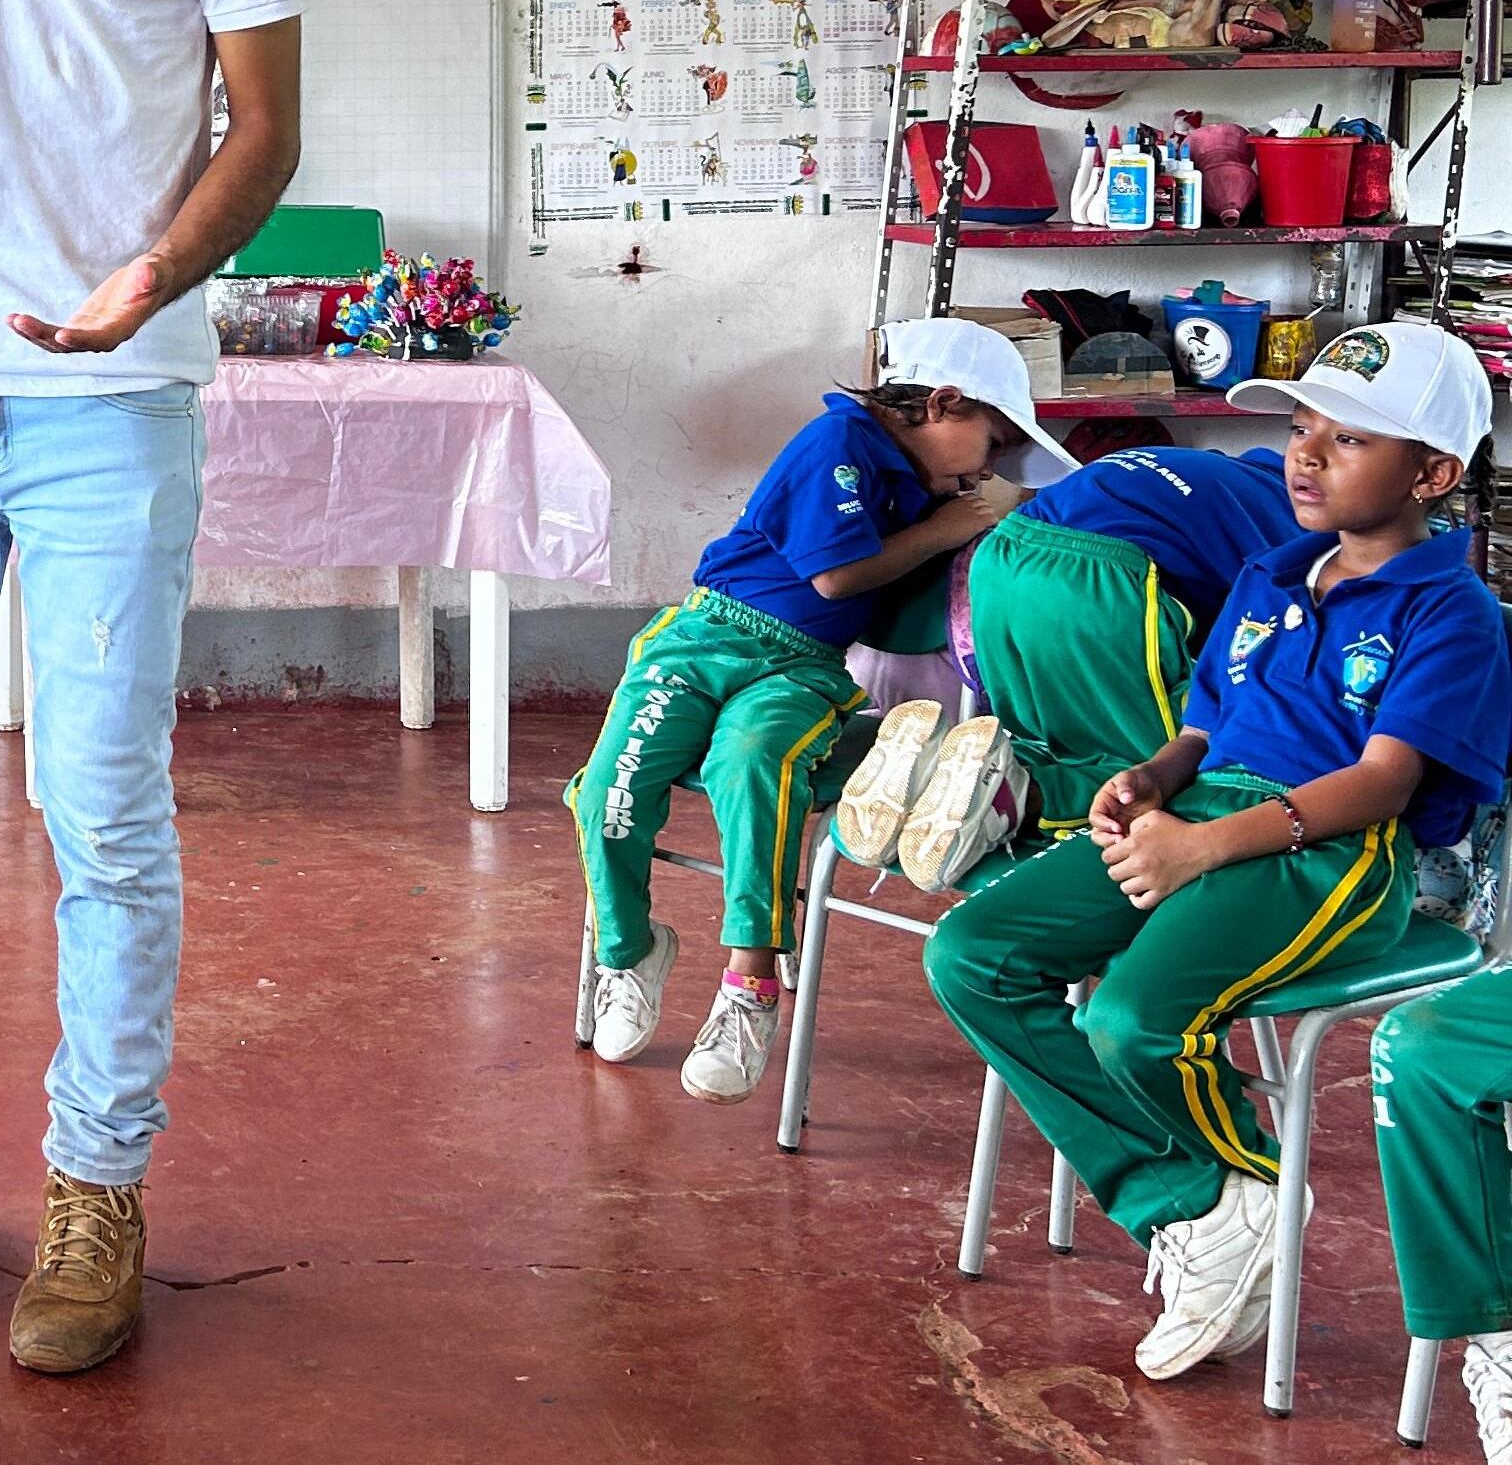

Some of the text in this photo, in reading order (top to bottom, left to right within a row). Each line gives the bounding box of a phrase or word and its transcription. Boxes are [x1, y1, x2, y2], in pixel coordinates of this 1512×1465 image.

[1156, 467, 1193, 496] AGUA
[602, 689, 674, 840] SAN ISIDRO
